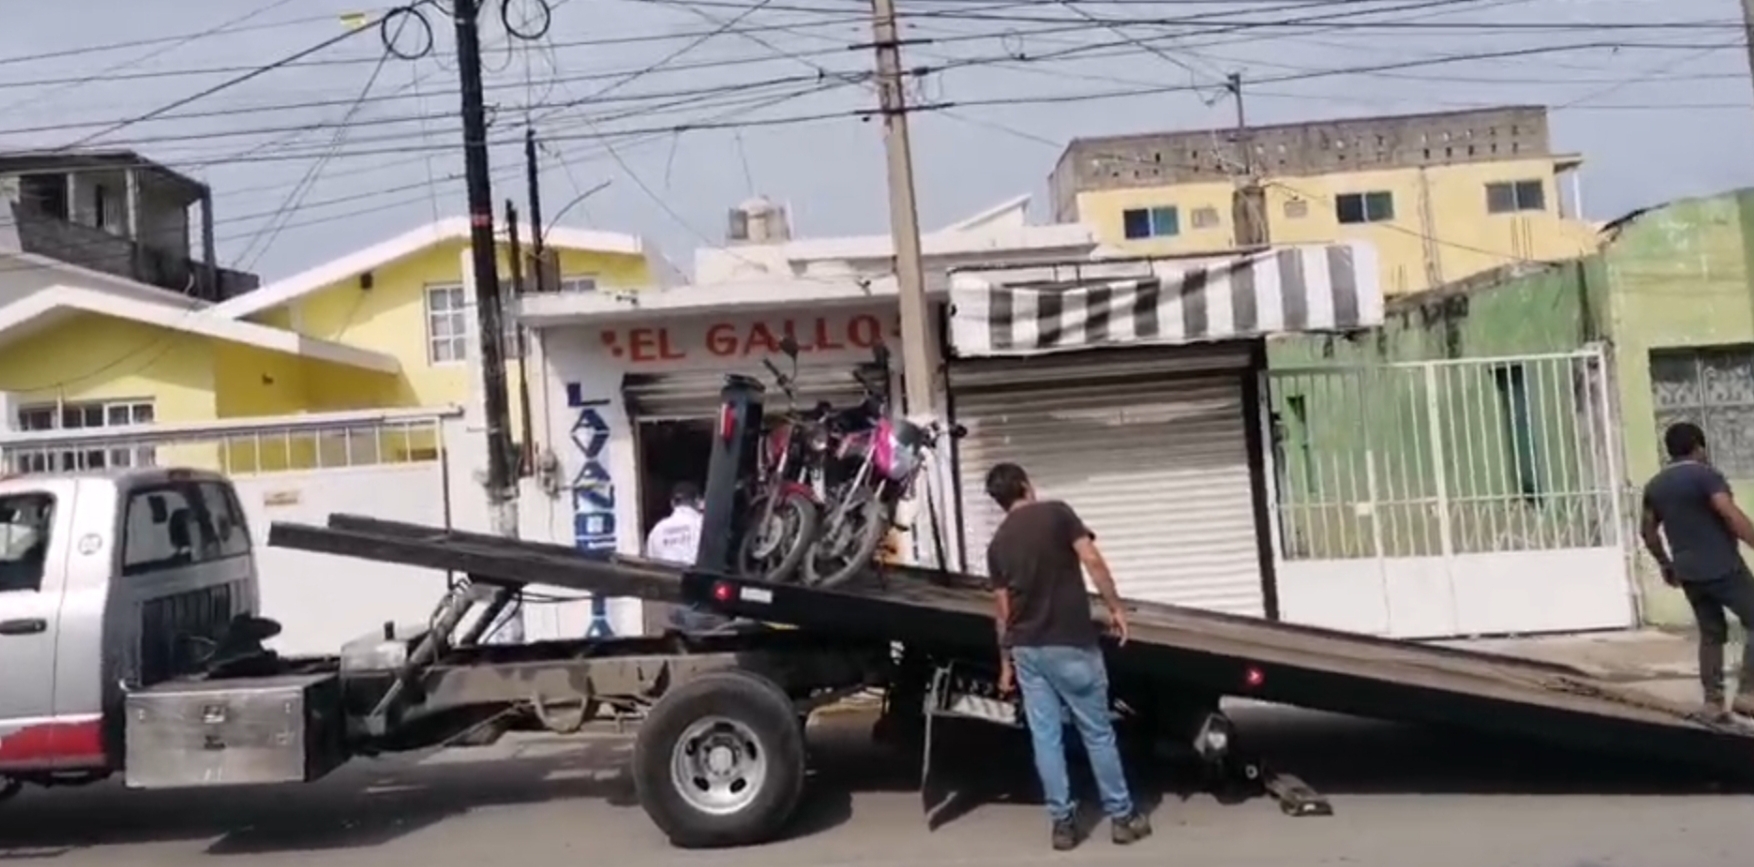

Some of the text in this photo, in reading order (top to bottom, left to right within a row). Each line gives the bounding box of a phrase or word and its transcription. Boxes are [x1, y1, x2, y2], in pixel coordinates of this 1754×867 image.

[629, 314, 882, 362] EL GALLO
[567, 382, 616, 640] LAVANDEIA
